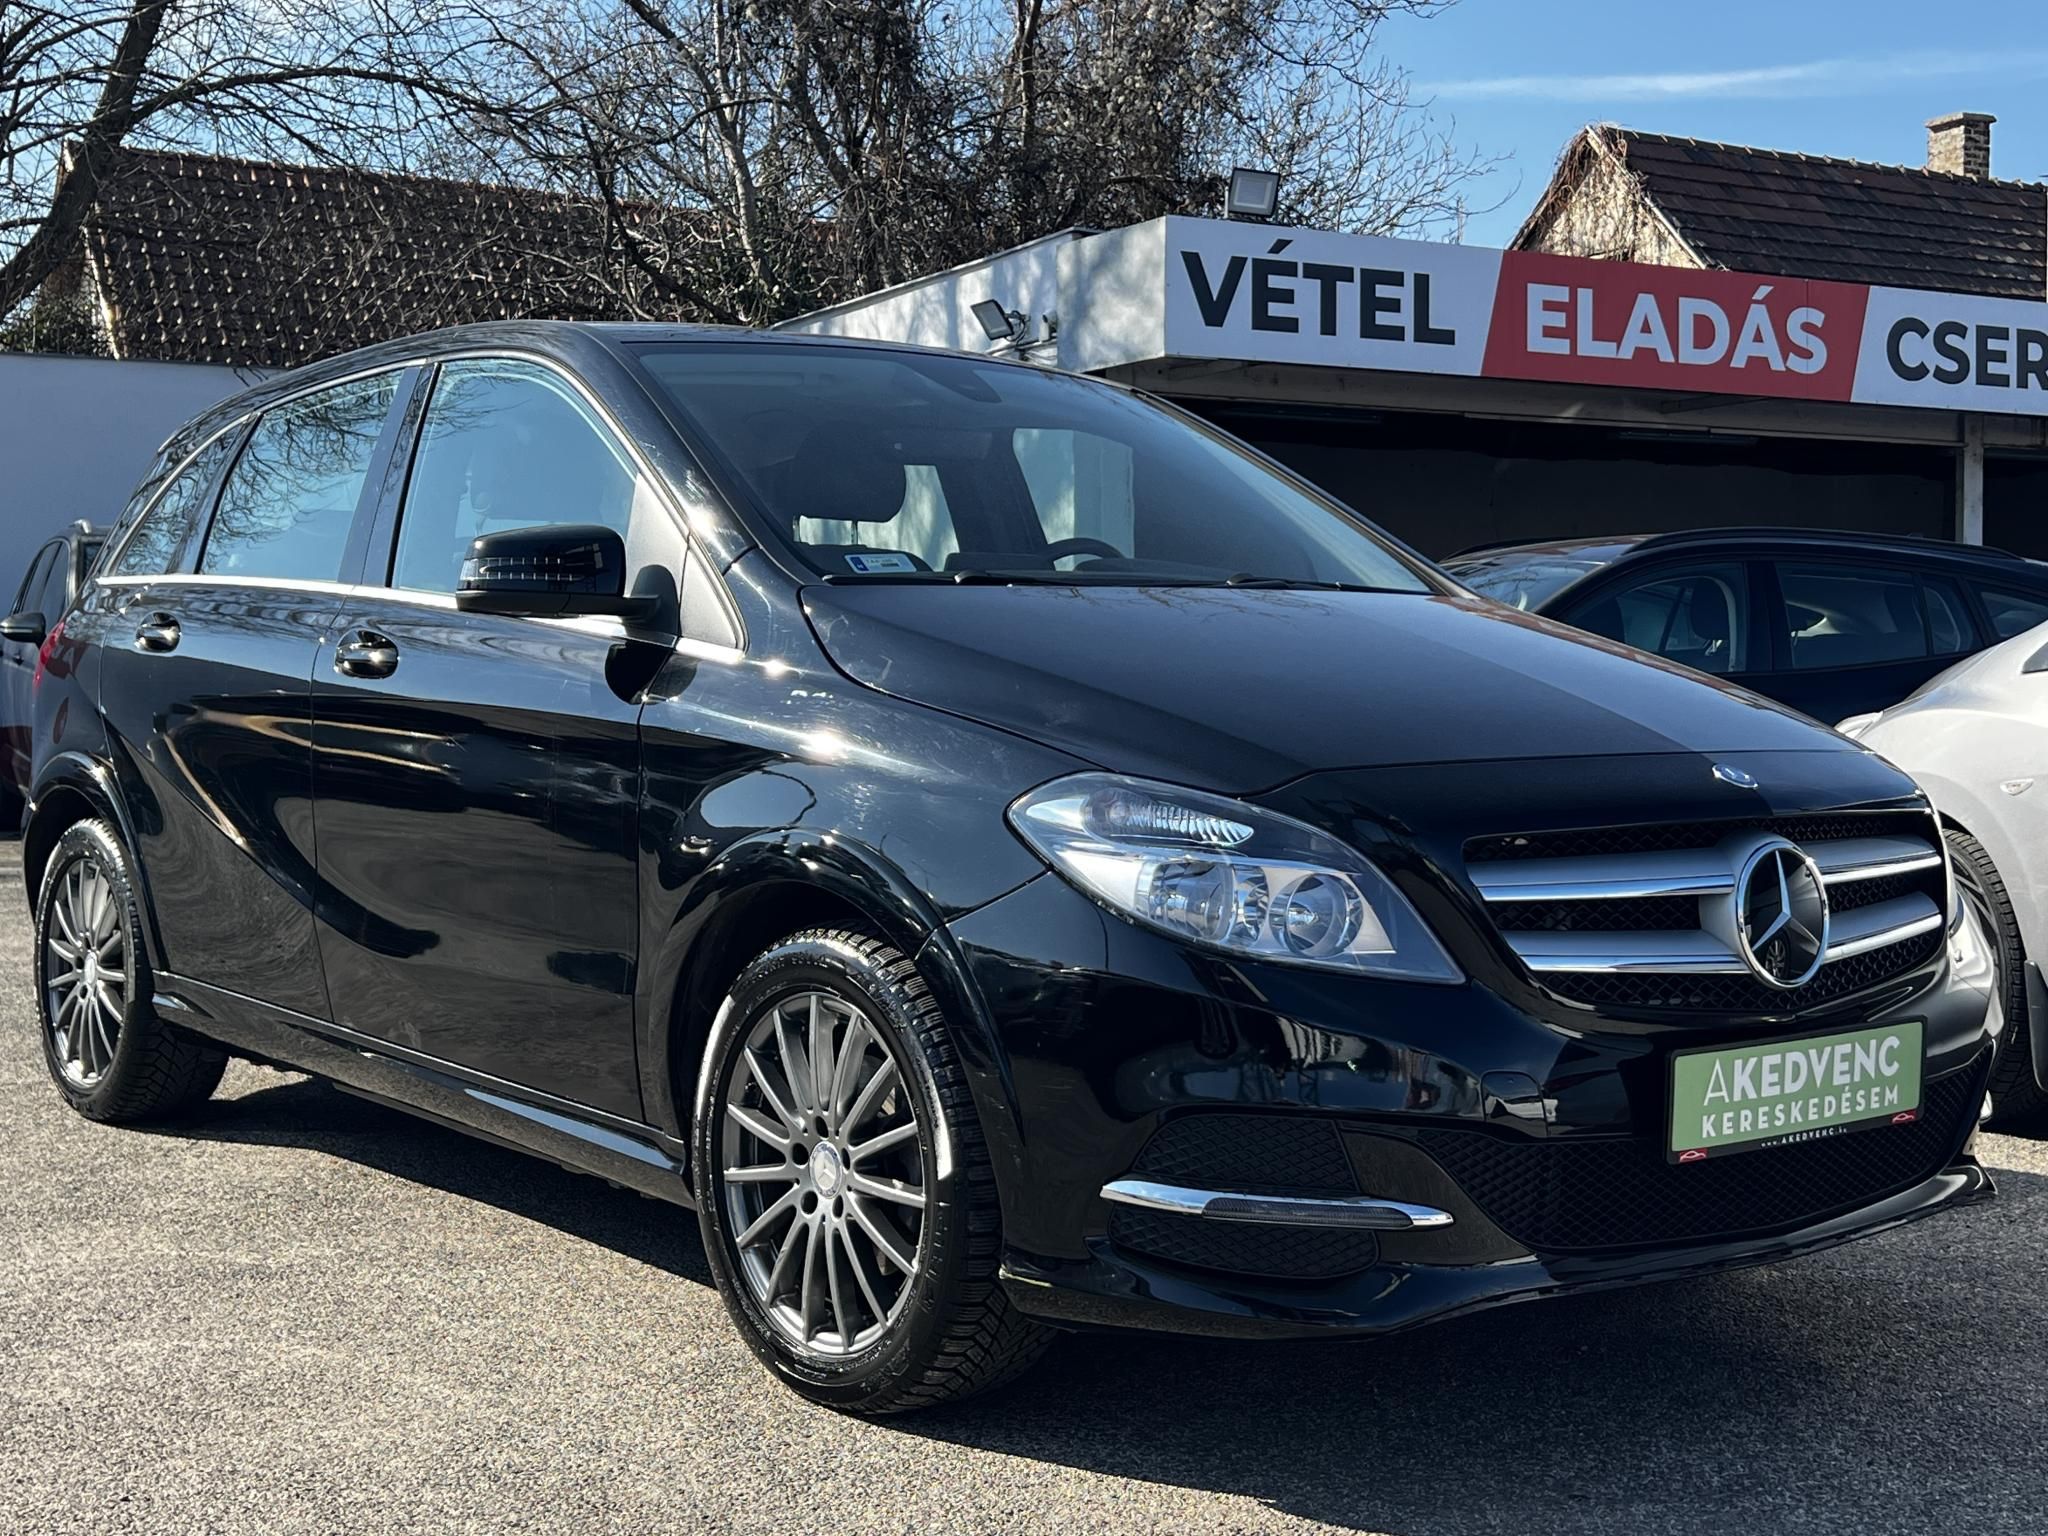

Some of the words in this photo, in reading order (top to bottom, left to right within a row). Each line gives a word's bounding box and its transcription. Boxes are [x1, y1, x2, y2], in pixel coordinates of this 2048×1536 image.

[1181, 238, 1455, 345] VÉTEL
[1526, 284, 1828, 374] ELADÁS
[1886, 317, 2048, 391] CSER
[1702, 1084, 1898, 1138] KERESKEDÉSEM
